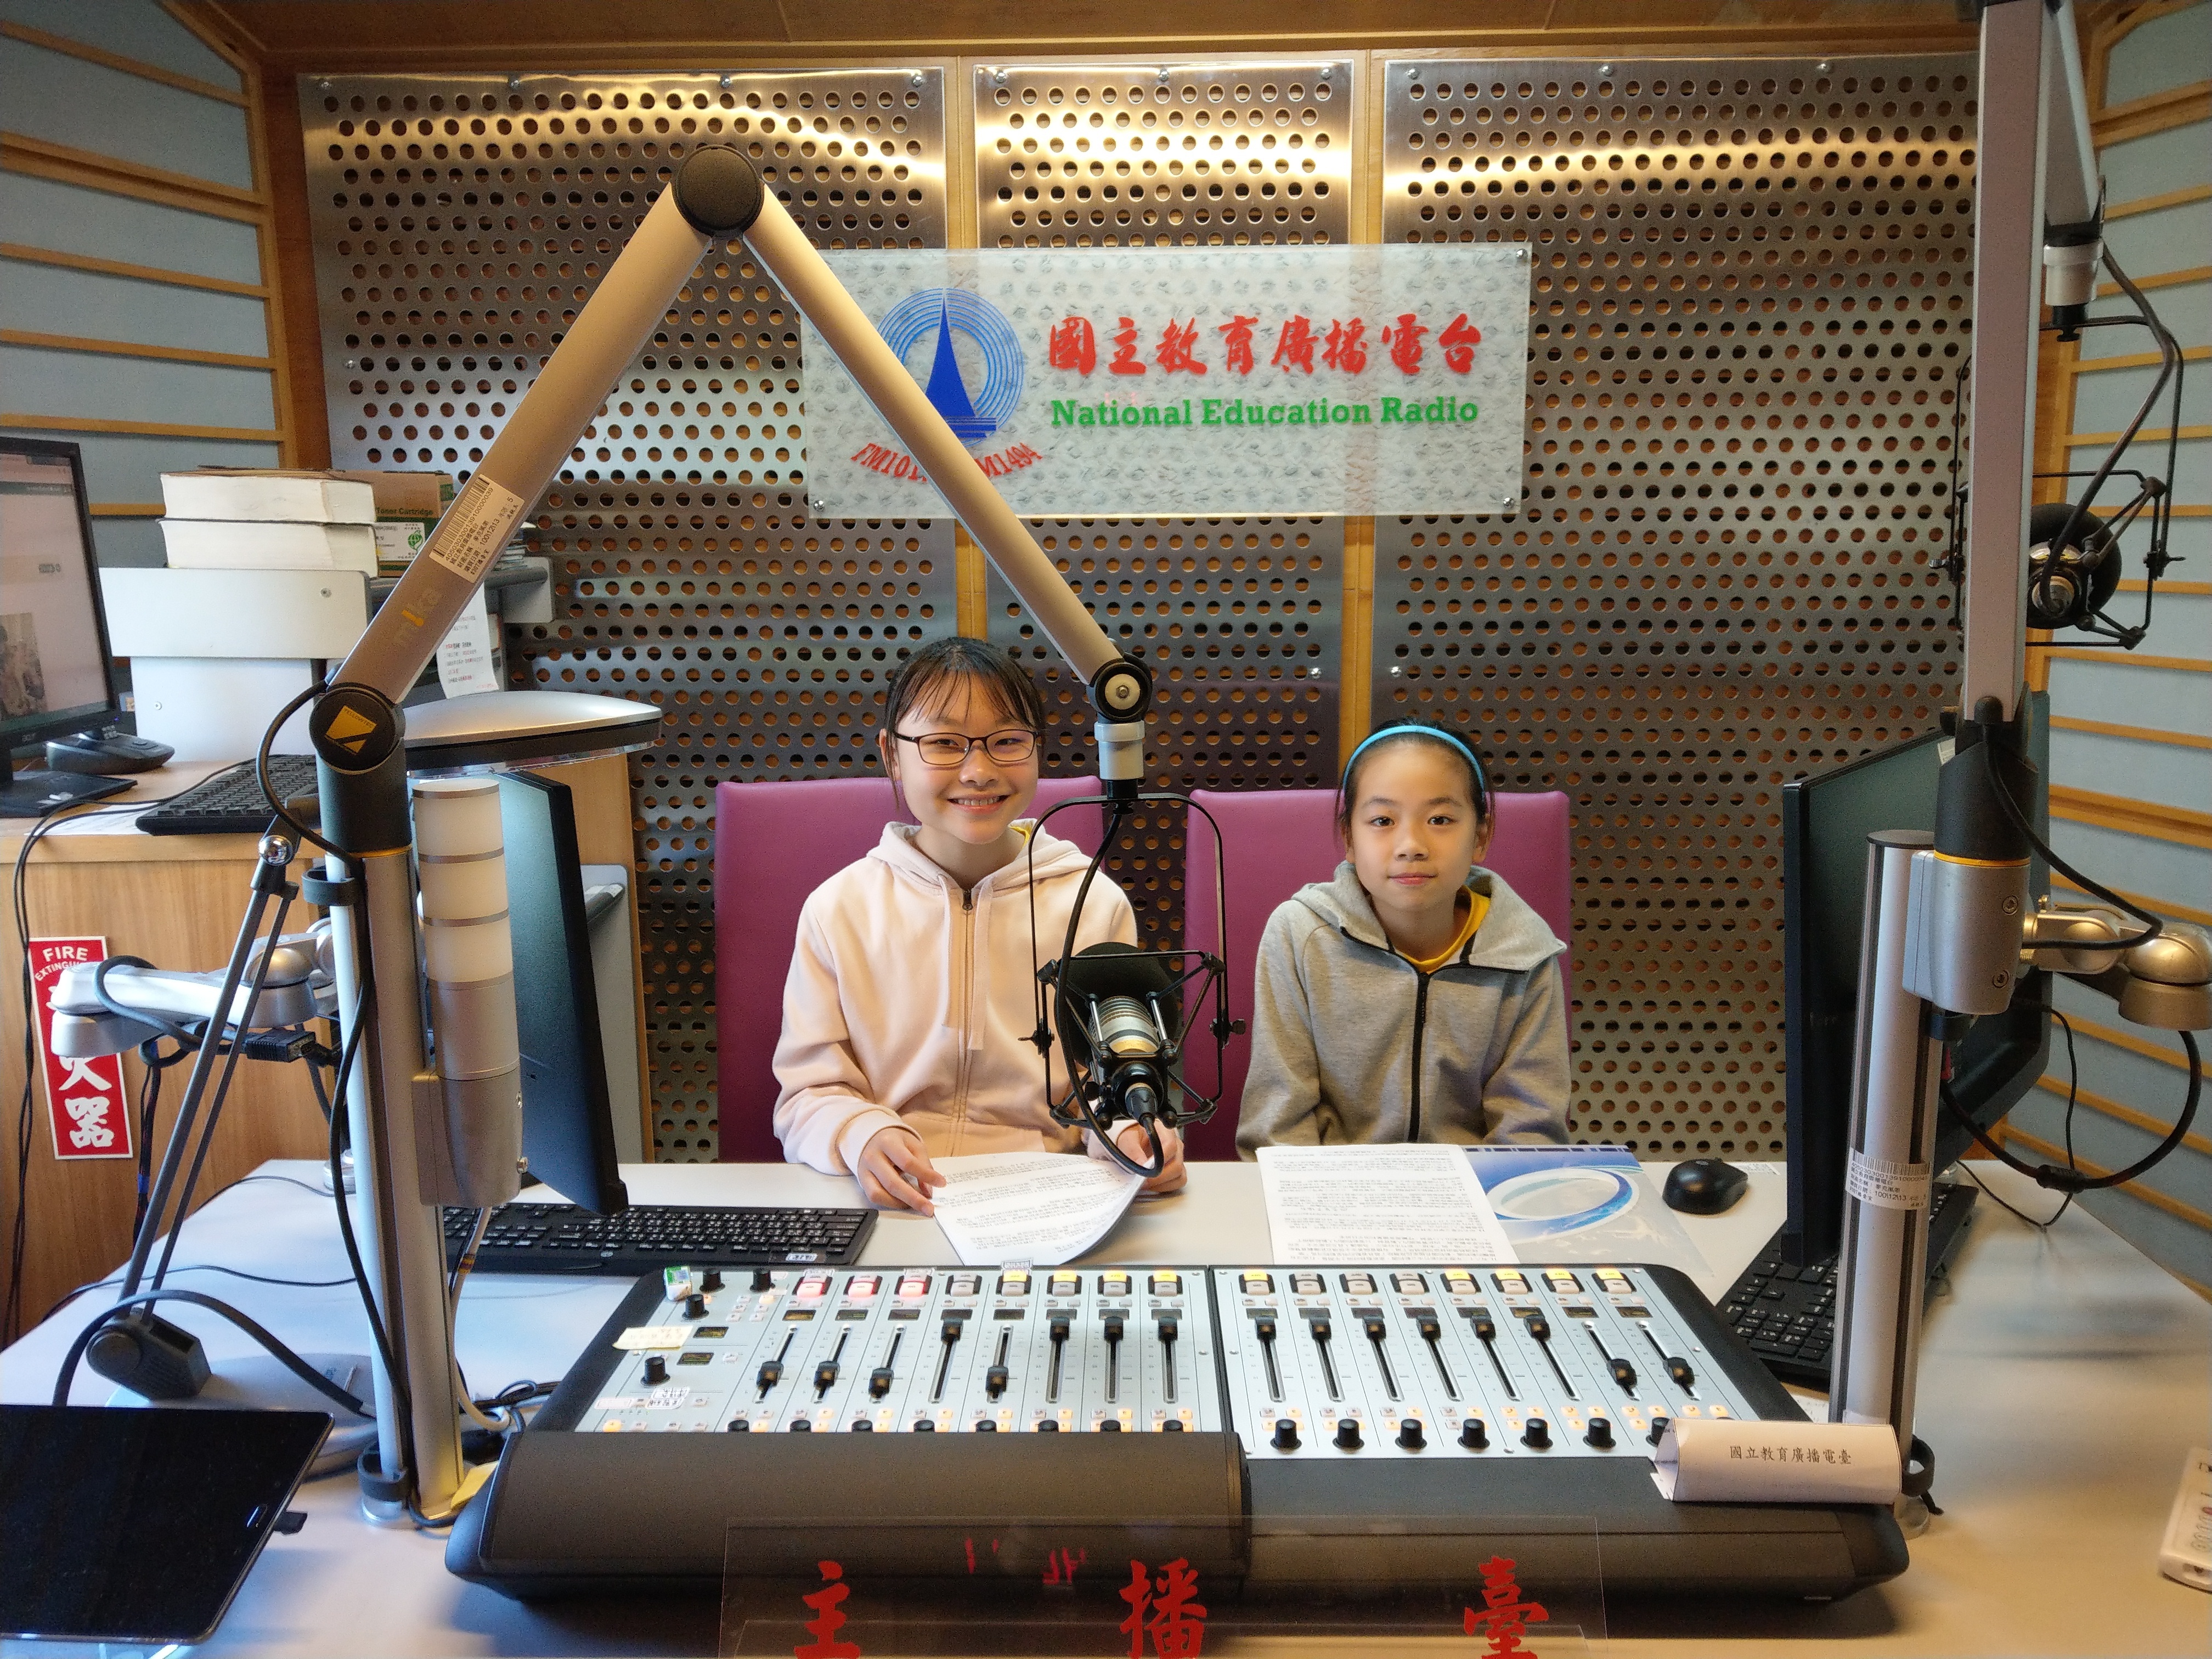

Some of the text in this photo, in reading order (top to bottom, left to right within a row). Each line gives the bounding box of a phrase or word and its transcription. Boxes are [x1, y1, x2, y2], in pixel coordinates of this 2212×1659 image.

[1051, 396, 1479, 426] National Education Radio
[850, 442, 1043, 483] FM101. M1494
[399, 507, 433, 516] Cartridge
[42, 946, 88, 962] FIRE
[1729, 1445, 1852, 1464] 國立教育廣播電臺
